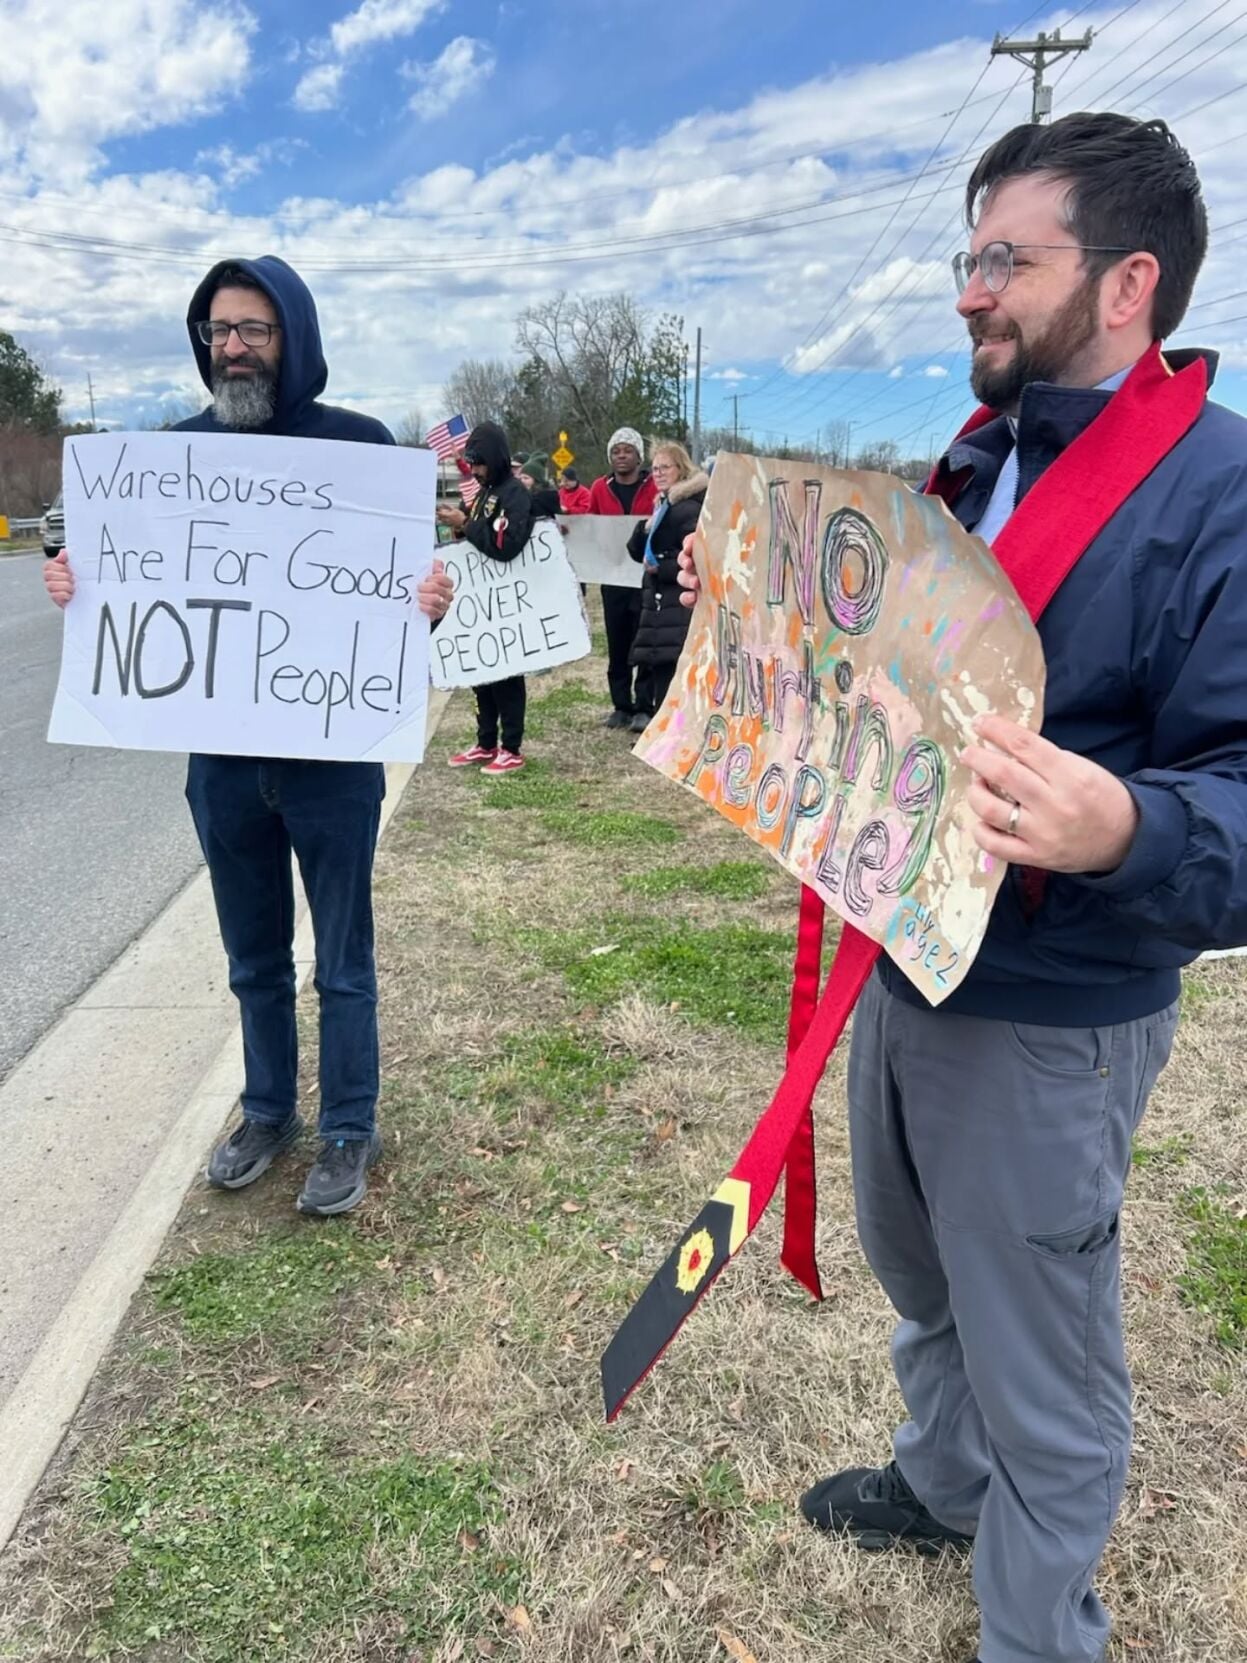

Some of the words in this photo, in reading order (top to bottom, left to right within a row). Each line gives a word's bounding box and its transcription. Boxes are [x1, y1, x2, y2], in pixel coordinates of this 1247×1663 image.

[71, 443, 334, 511] Warehouses
[98, 523, 164, 585] Are
[185, 519, 268, 587] For
[287, 529, 413, 605] Goods,
[767, 477, 888, 636] NO
[456, 580, 534, 629] OVER
[91, 598, 252, 699] NOT
[254, 609, 408, 739] People!
[436, 613, 569, 679] PEOPLE
[905, 920, 940, 968] age
[936, 951, 959, 985] 2
